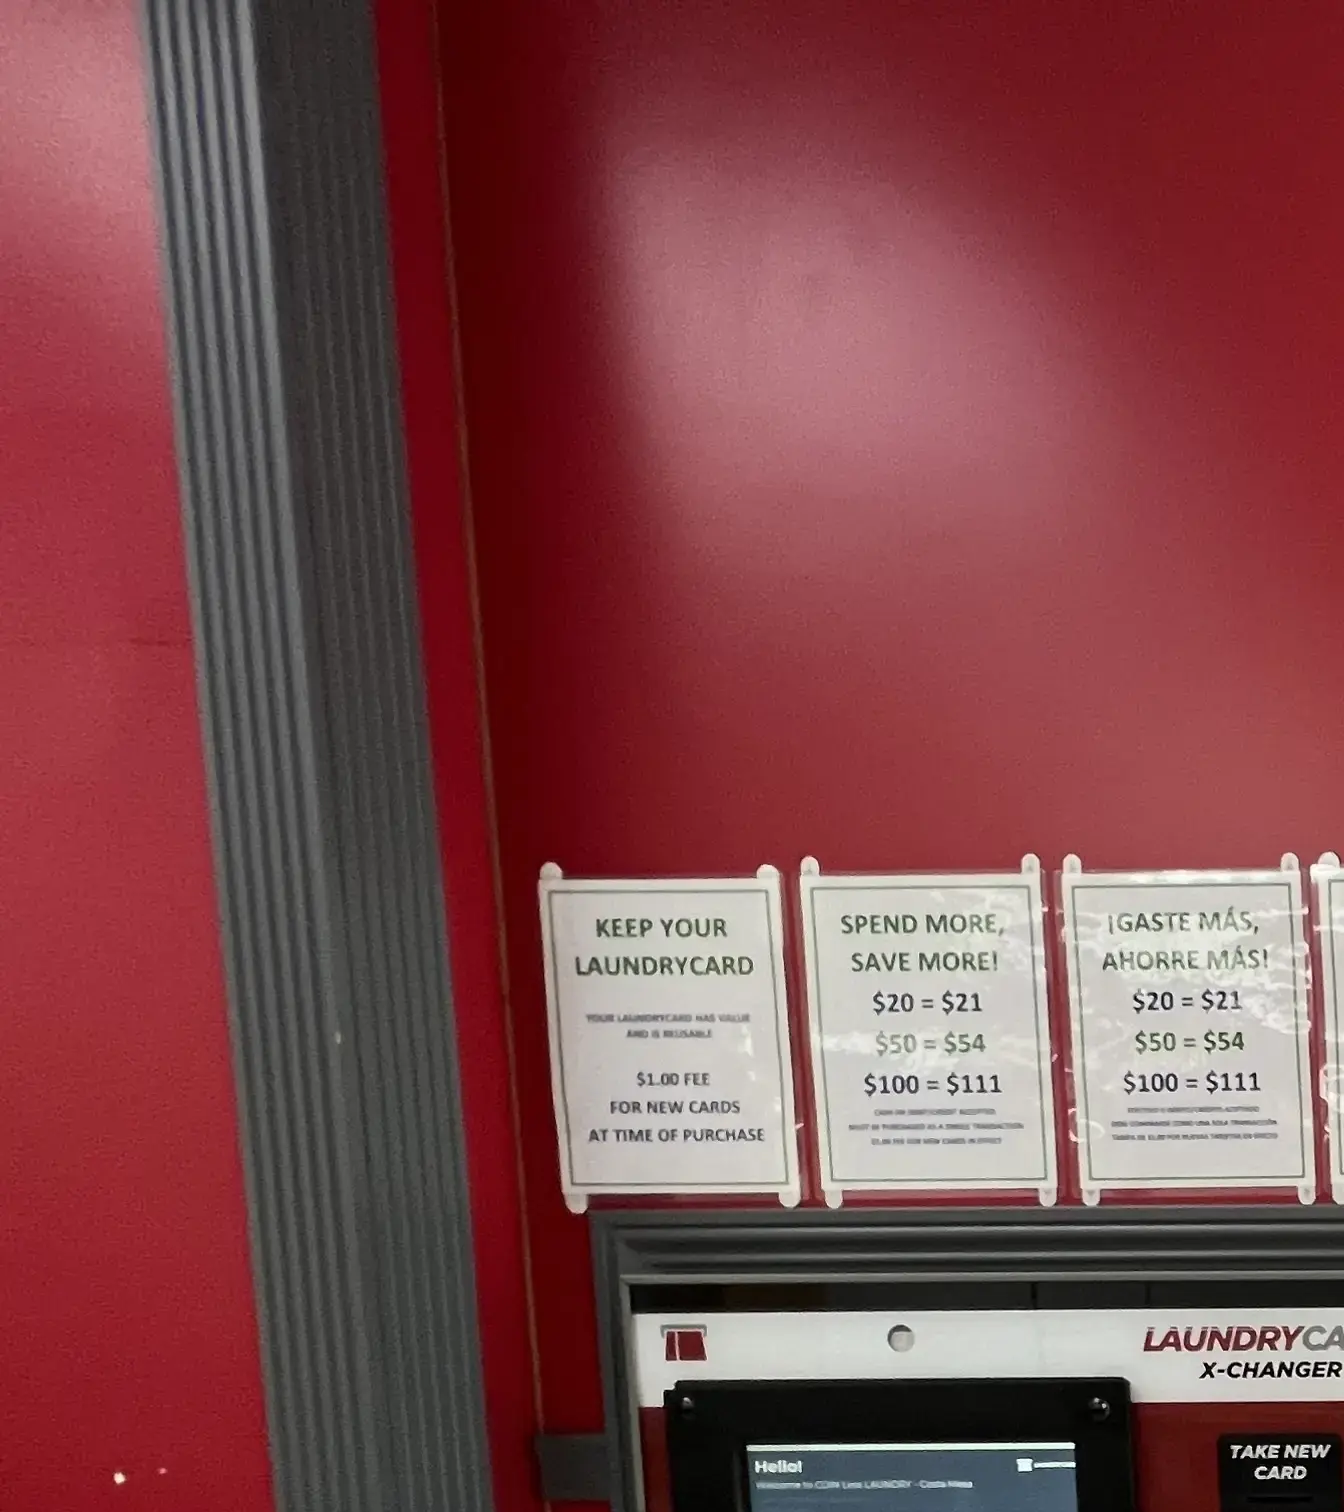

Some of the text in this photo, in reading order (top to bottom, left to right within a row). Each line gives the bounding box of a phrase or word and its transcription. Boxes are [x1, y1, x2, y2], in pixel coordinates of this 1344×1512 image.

[596, 918, 727, 938] KEEP YOUR
[841, 914, 1004, 936] SPEND MORE,
[1108, 905, 1259, 935] ¡GASTE MÁS,
[575, 956, 754, 976] LAUNDRYCARD
[852, 951, 997, 972] SAVE MORE!
[1102, 945, 1268, 972] AHORRE MÁS!
[637, 1072, 710, 1088] $1.00 FEE
[1199, 1361, 1342, 1379] X-CHANGER
[1230, 1444, 1331, 1459] TAKE NEW
[755, 1460, 803, 1473] Hello!
[1254, 1466, 1307, 1480] CARD
